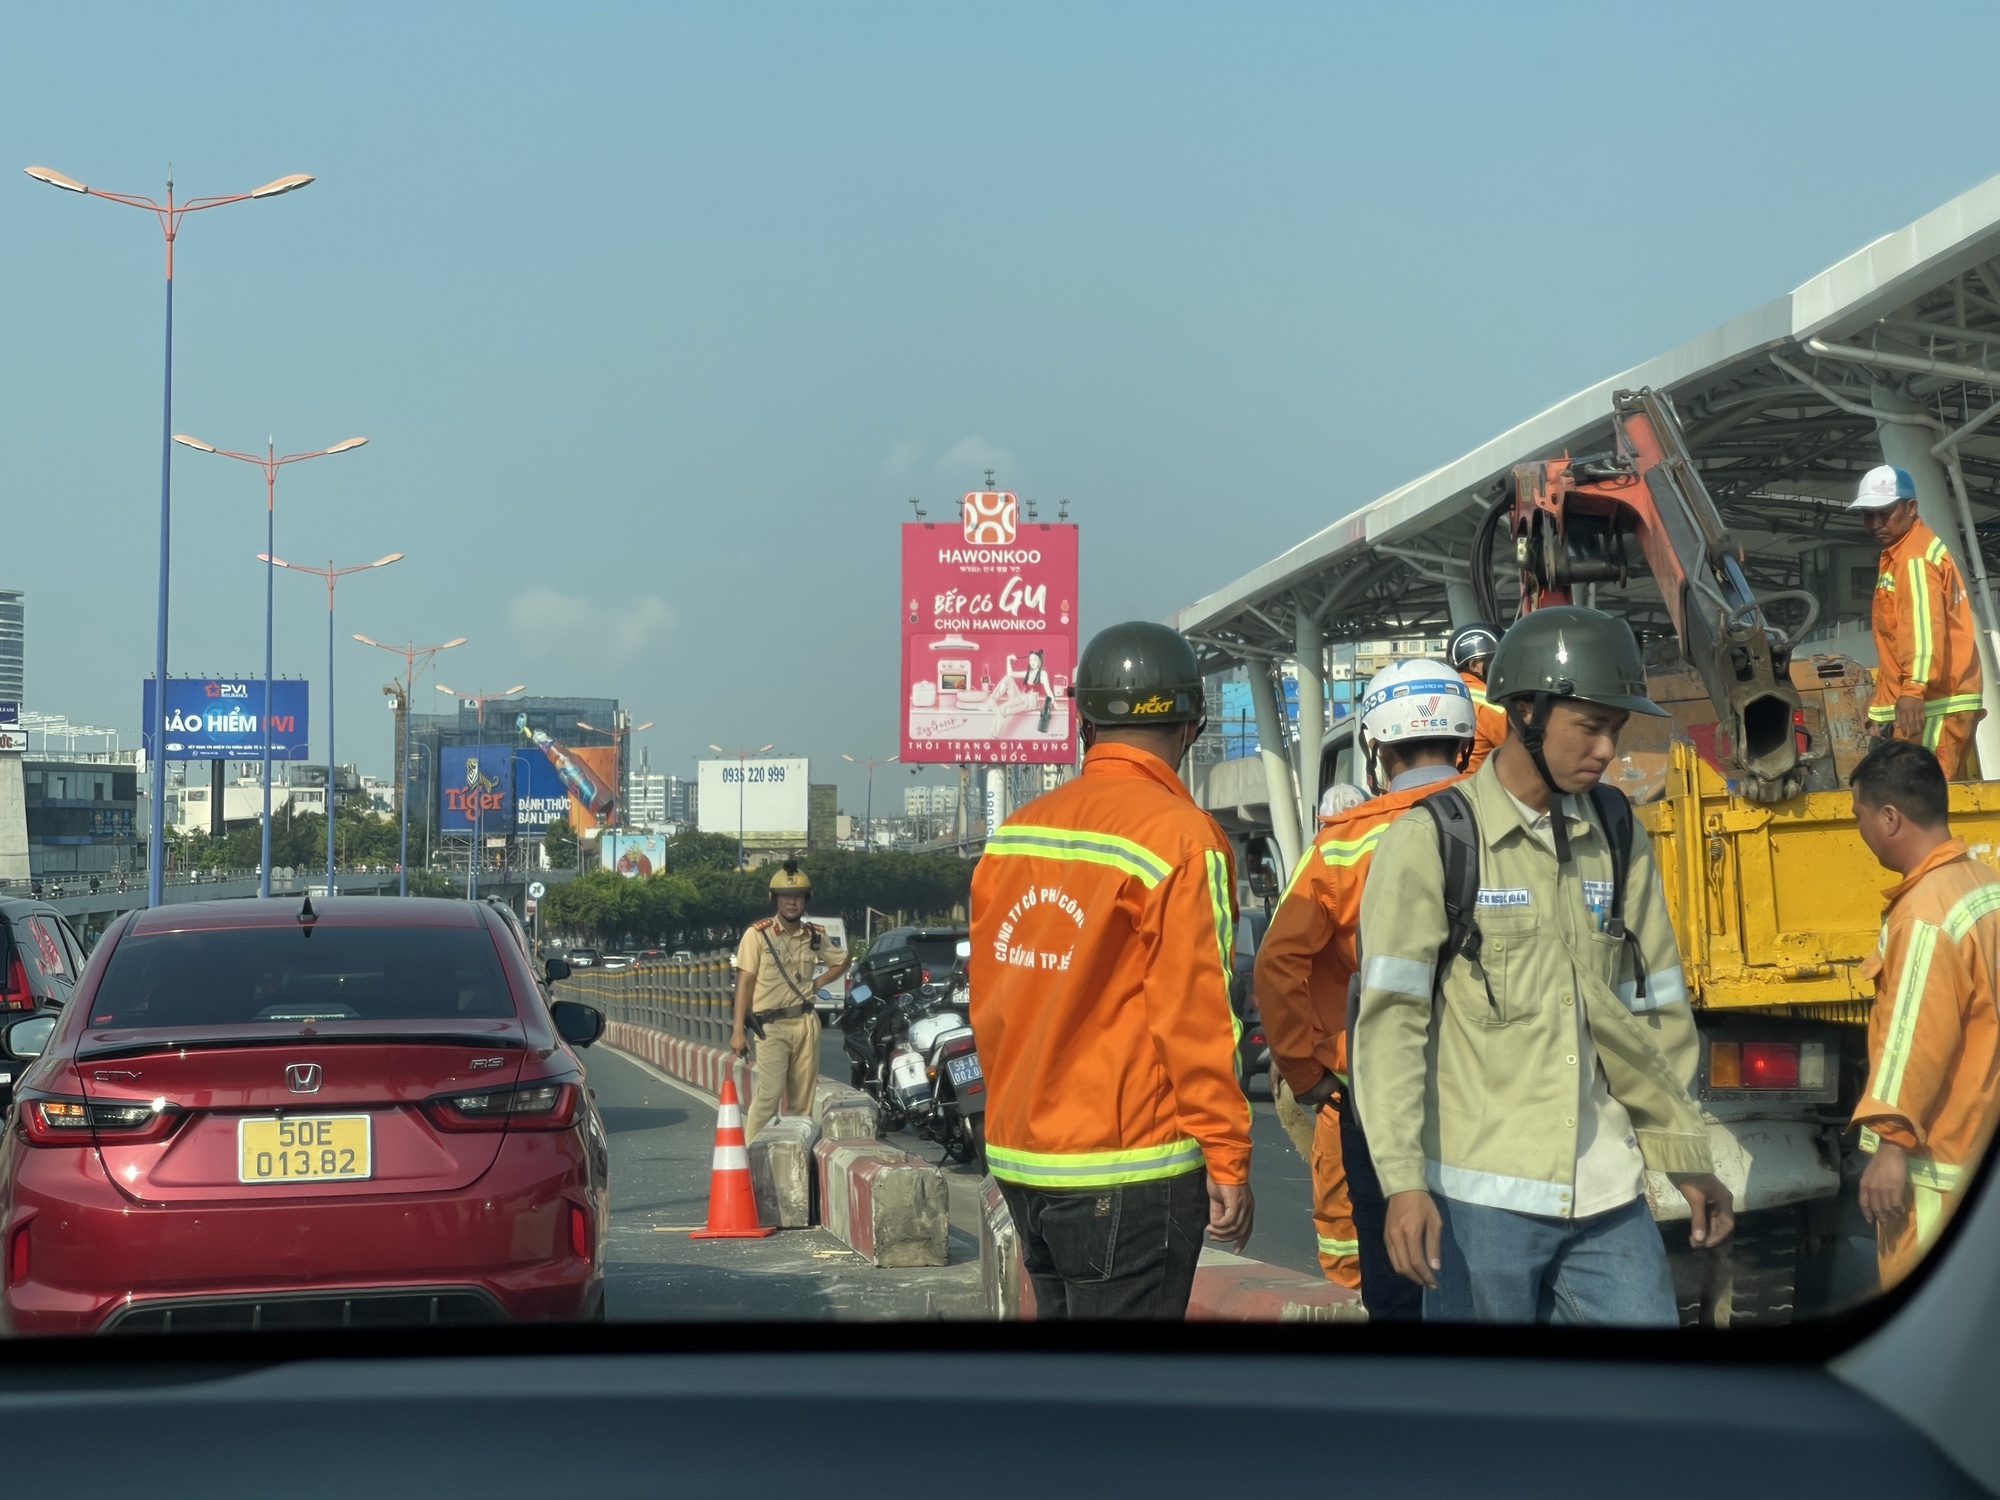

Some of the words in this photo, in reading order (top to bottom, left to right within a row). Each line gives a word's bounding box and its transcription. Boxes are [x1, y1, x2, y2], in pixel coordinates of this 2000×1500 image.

[938, 549, 1041, 564] HAWONKOO
[933, 587, 967, 615] BẾP
[934, 619, 971, 632] CHỌN
[973, 619, 1046, 630] HAWONKOO
[220, 684, 247, 694] PVI
[207, 706, 257, 732] HIỂM
[1411, 719, 1448, 728] CTEG
[908, 740, 939, 750] THỜI
[948, 742, 991, 750] TRANG
[1000, 742, 1024, 750] GIA
[1032, 742, 1069, 752] DỤNG
[955, 751, 981, 761] HÀN
[990, 751, 1028, 761] QUỐC
[748, 766, 765, 783] 220
[768, 766, 785, 783] 999
[518, 796, 545, 810] ĐÁNH
[546, 795, 572, 810] THỨC
[993, 921, 1014, 962] CÔNG
[1008, 902, 1022, 923] TY
[1022, 885, 1037, 909] CỔ
[469, 1057, 504, 1070] RS
[94, 1070, 142, 1082] CITY
[279, 1120, 332, 1147] 50E
[256, 1149, 355, 1177] 013.82
